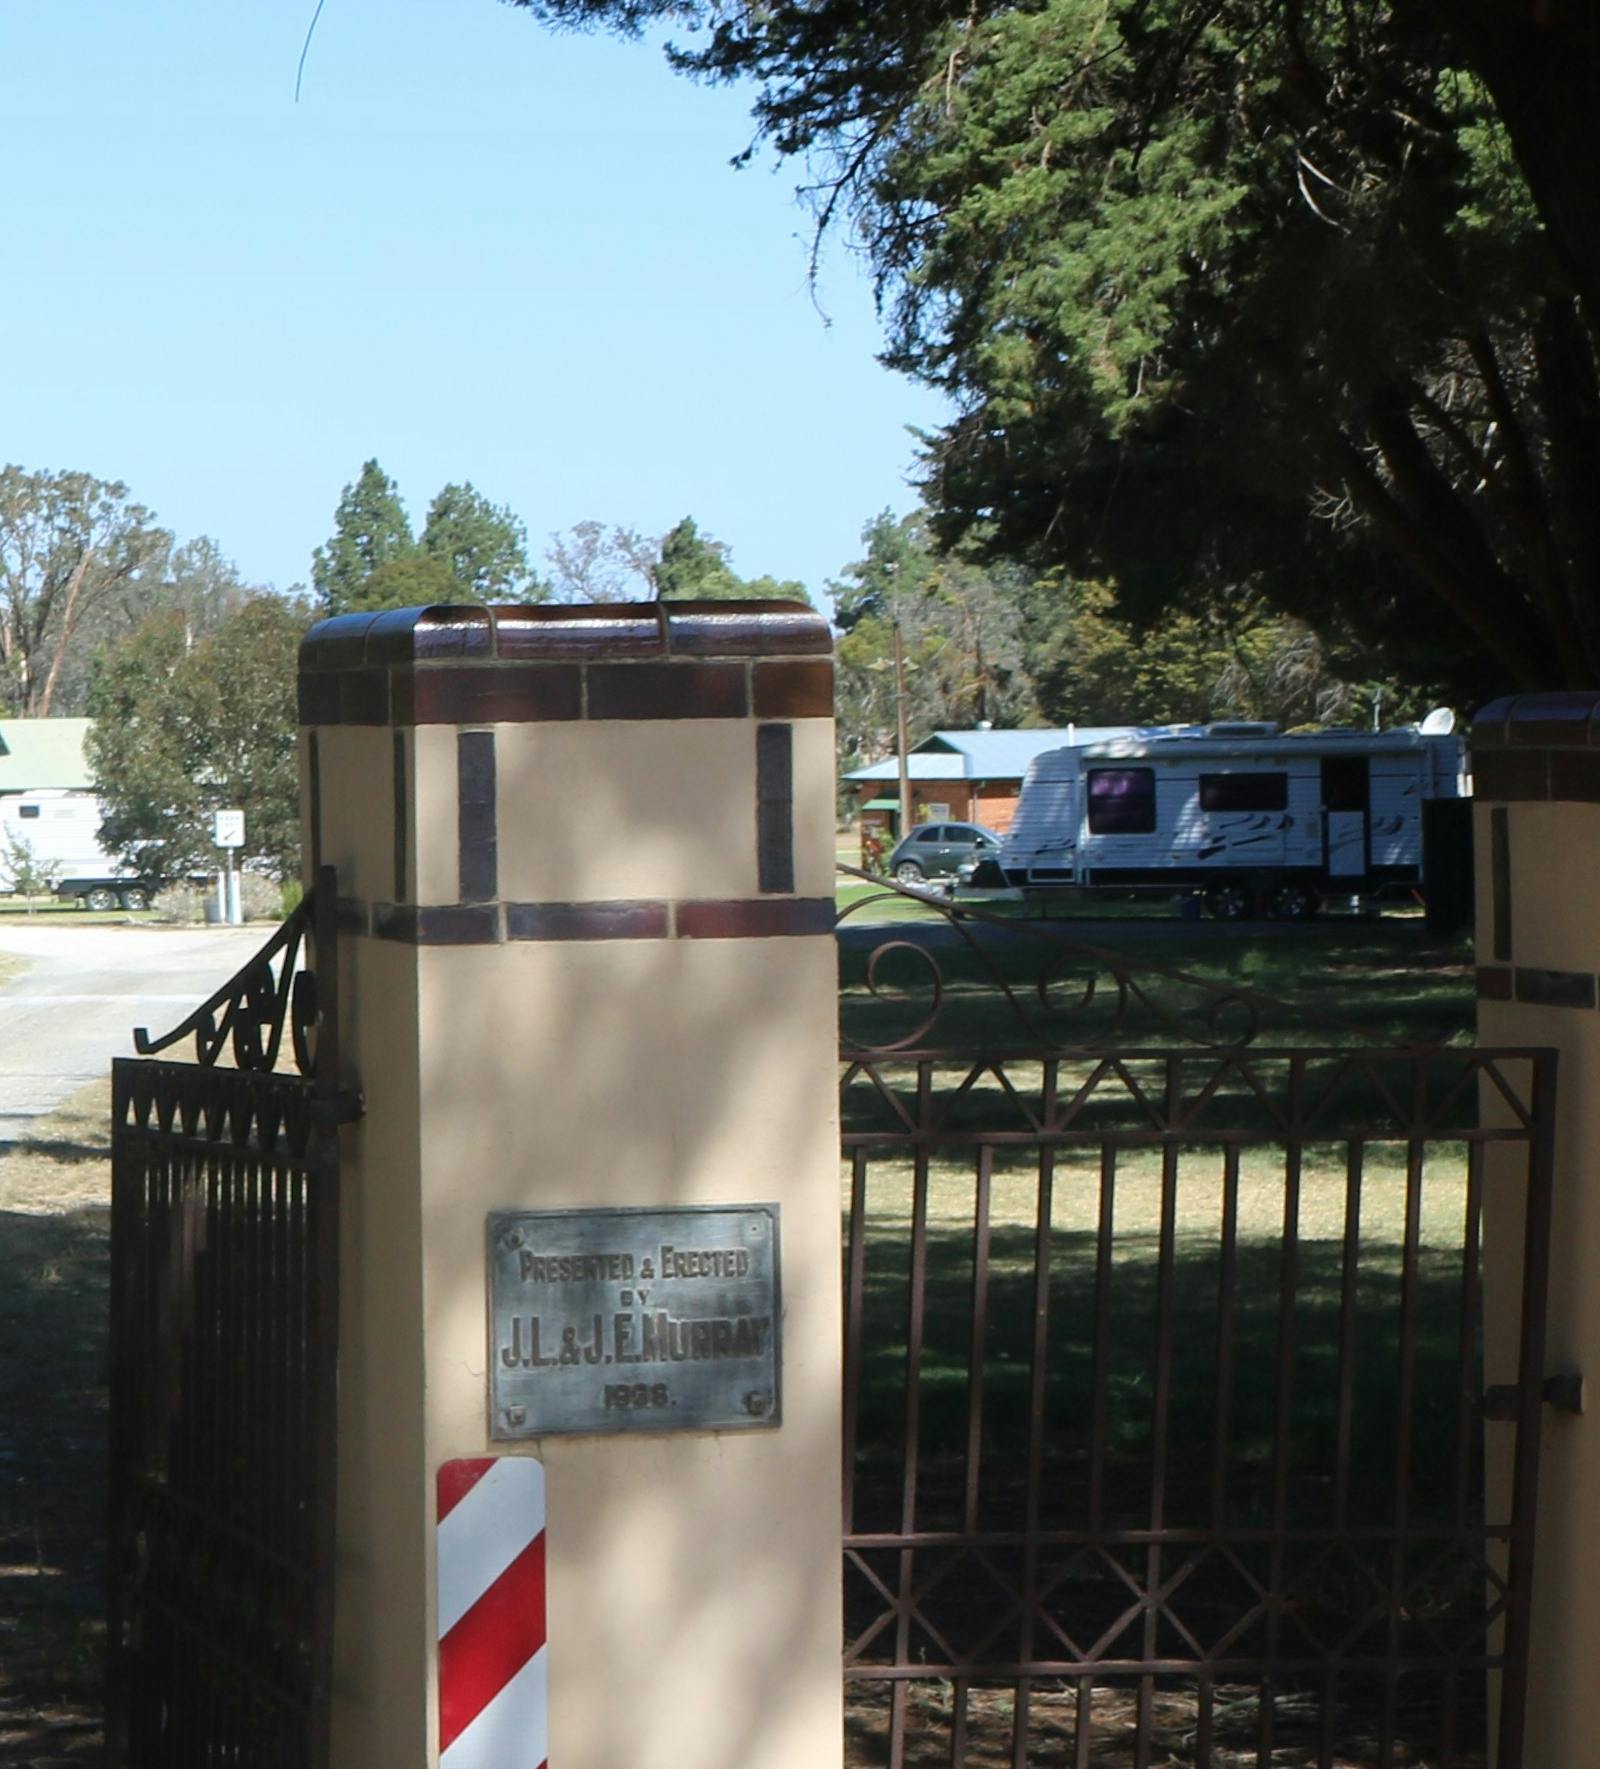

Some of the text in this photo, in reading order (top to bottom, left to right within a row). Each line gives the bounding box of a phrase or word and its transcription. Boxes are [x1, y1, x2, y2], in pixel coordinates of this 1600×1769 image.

[519, 1246, 750, 1283] PRESENTED & ERECTED
[619, 1289, 651, 1307] BY
